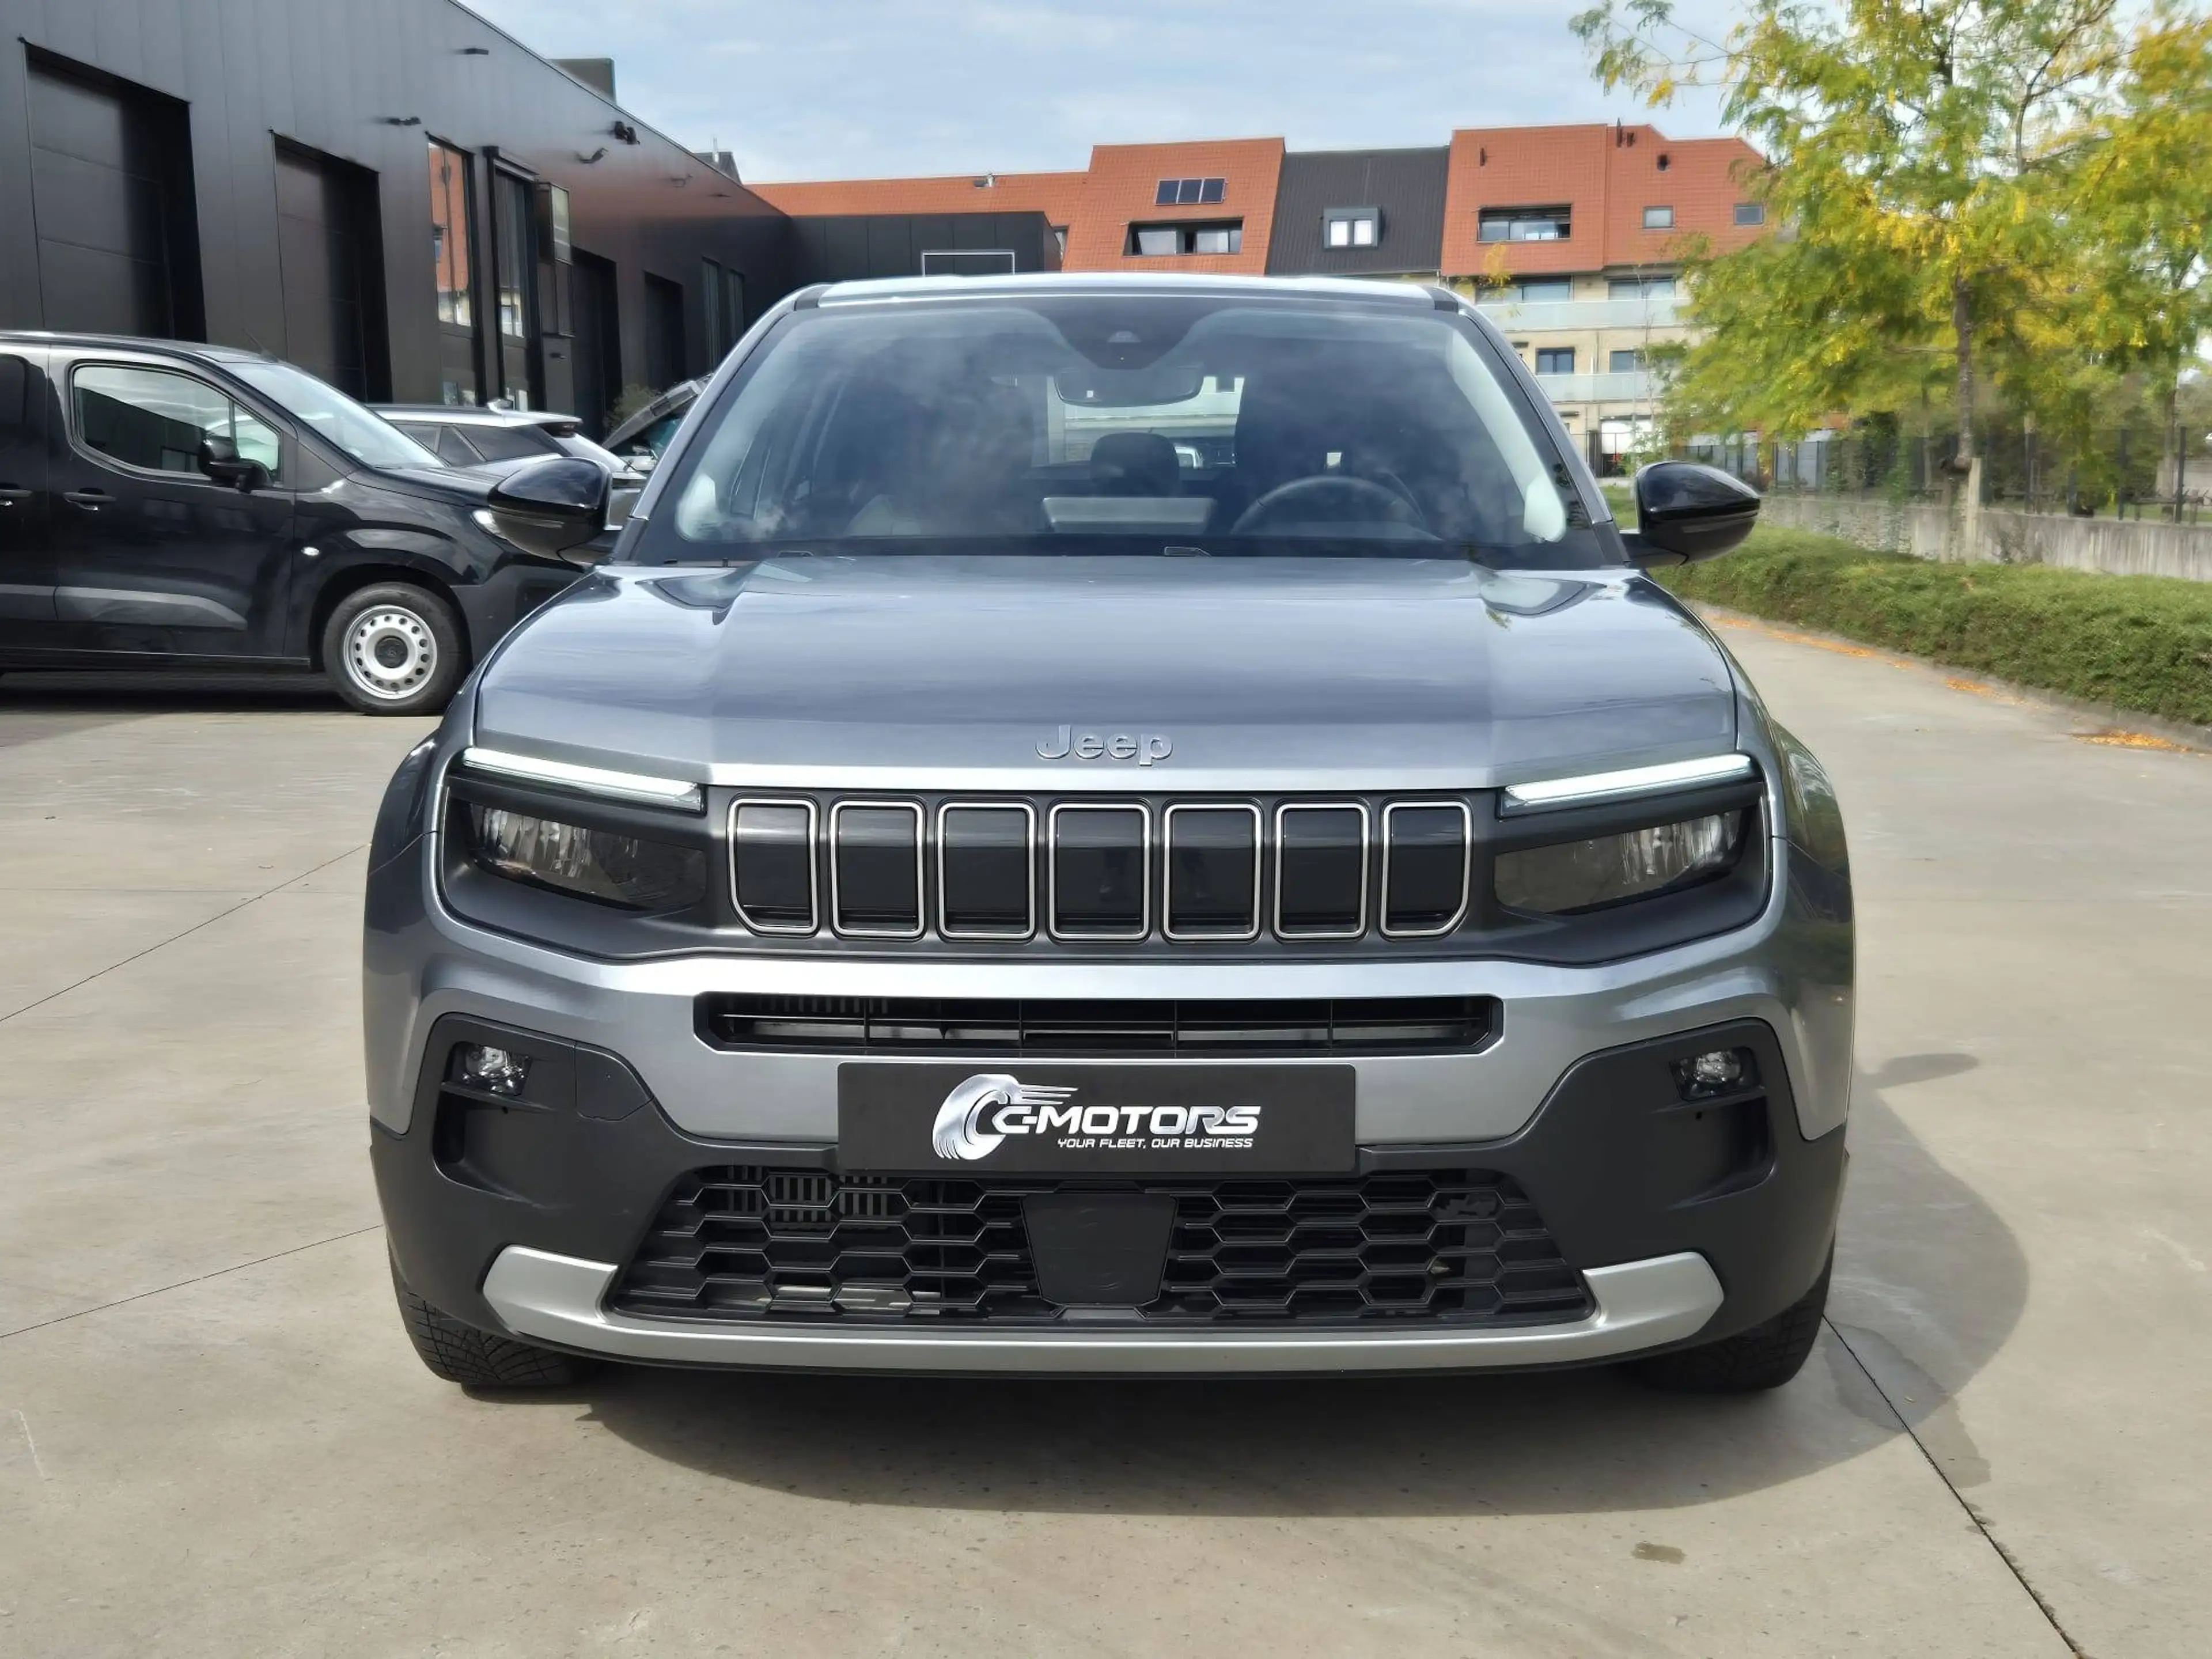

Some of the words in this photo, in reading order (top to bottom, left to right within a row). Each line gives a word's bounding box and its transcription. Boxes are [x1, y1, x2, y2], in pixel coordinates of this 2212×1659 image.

[1035, 725, 1173, 766] Jeep
[991, 1105, 1262, 1134] C-MOTORS
[1057, 1138, 1096, 1148] YOUR
[1099, 1138, 1146, 1149] FLEET,
[1151, 1138, 1180, 1148] OUR
[1184, 1138, 1254, 1148] BUSINESS
